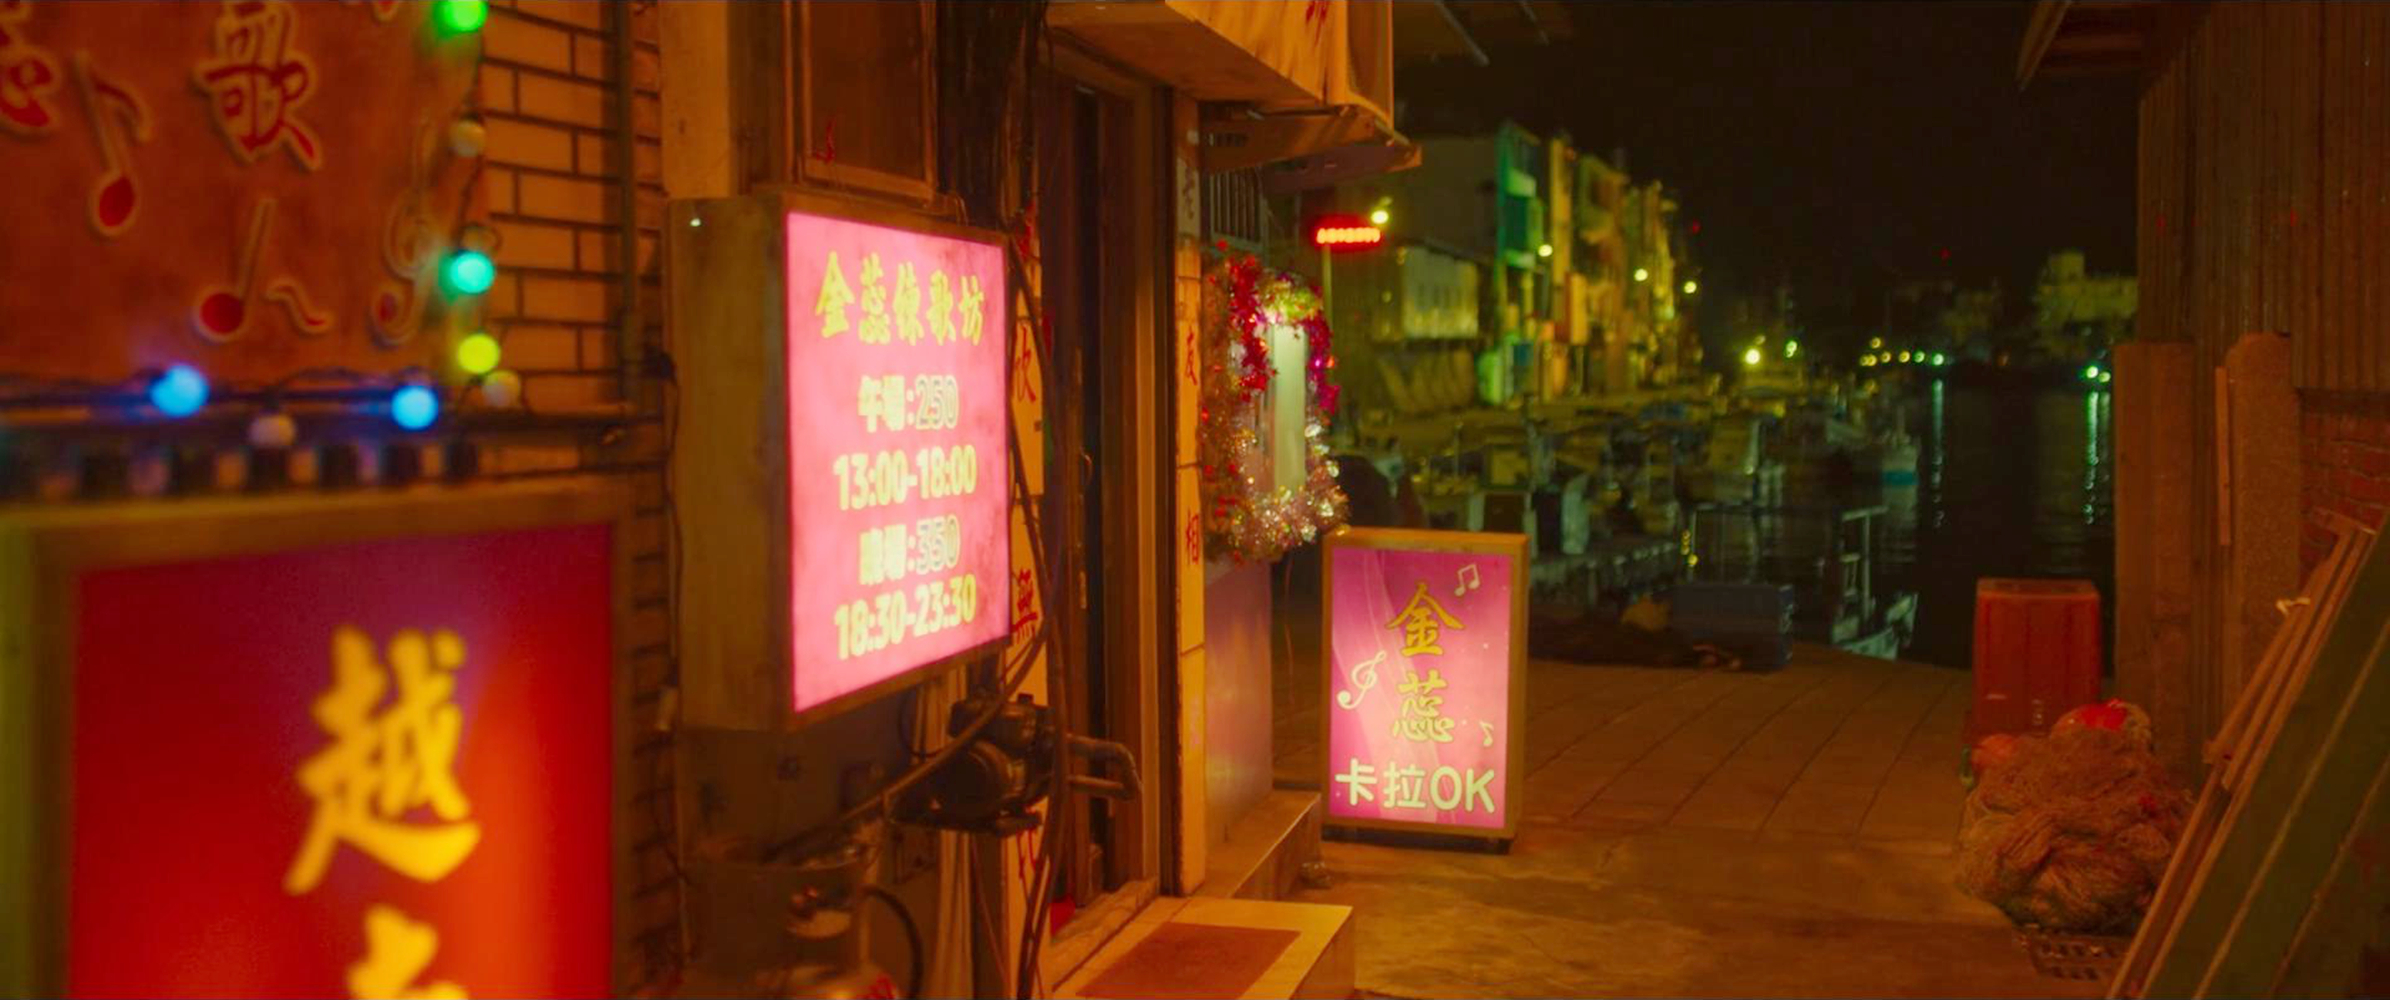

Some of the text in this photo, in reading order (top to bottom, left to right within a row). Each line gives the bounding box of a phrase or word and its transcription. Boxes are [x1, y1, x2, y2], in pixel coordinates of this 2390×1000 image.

[833, 444, 977, 511] 13:00-18:00
[834, 573, 977, 661] 18:30-23:30
[1385, 580, 1465, 742] 金蕊
[1334, 757, 1496, 814] 卡拉OK
